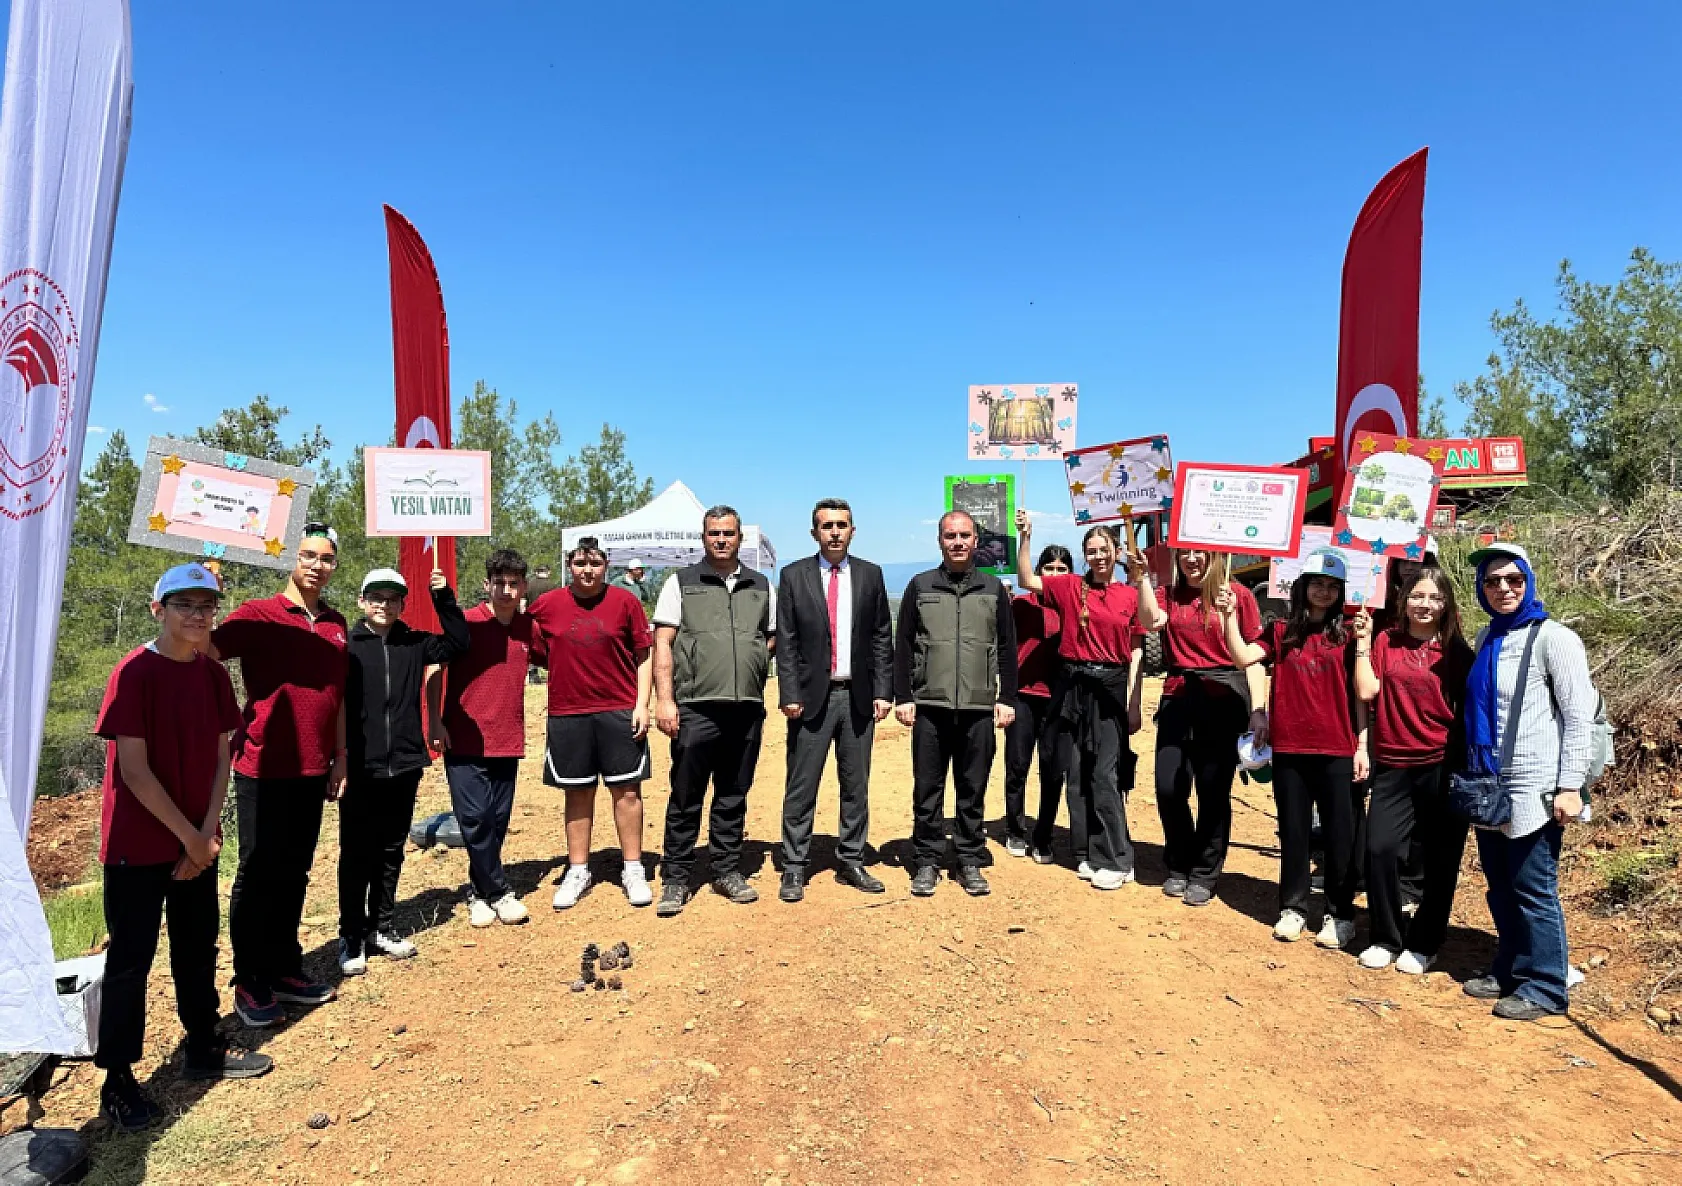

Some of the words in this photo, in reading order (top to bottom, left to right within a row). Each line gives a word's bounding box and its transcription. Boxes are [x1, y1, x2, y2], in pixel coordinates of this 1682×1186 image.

[1444, 447, 1480, 470] AN
[1494, 445, 1514, 458] 112
[1088, 487, 1157, 505] eTwinning
[429, 496, 471, 516] VATAN
[625, 531, 652, 541] ORMAN
